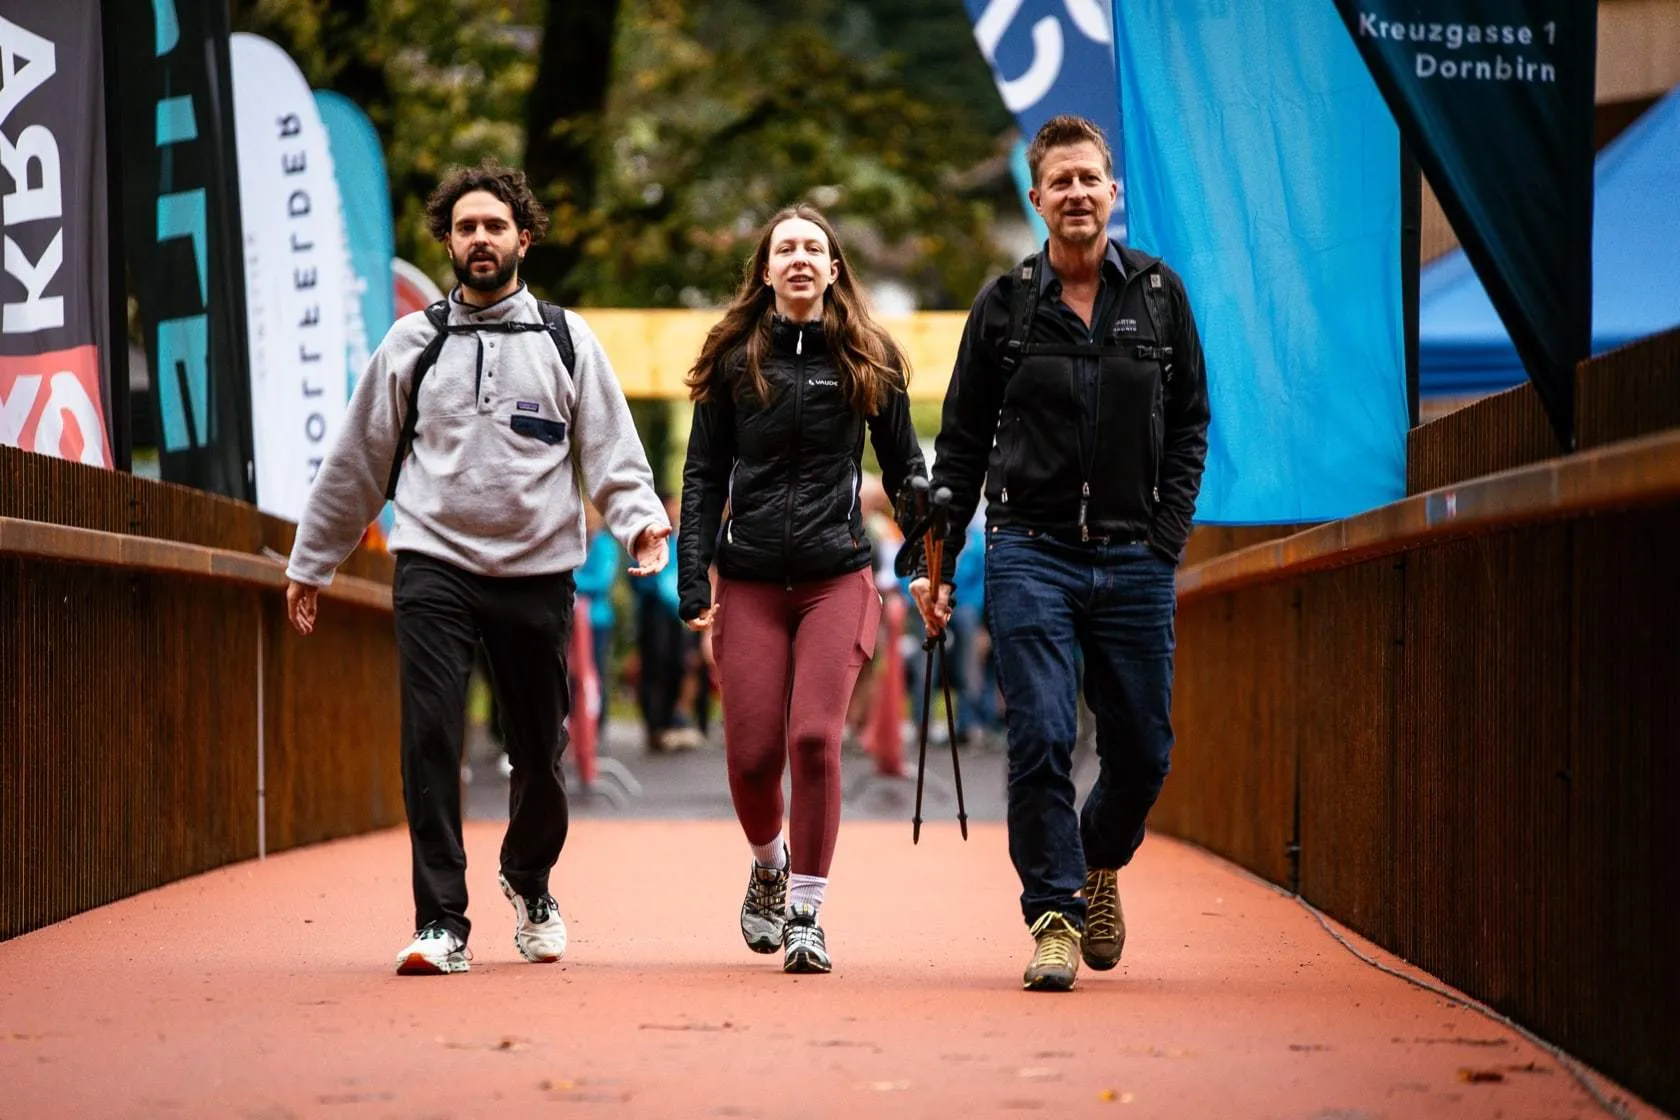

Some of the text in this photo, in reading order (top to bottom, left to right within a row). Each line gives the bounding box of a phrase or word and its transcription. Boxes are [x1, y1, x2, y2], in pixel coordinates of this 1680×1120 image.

[1359, 12, 1556, 49] Kreuzgasse 1
[1415, 53, 1556, 82] Dornbirn
